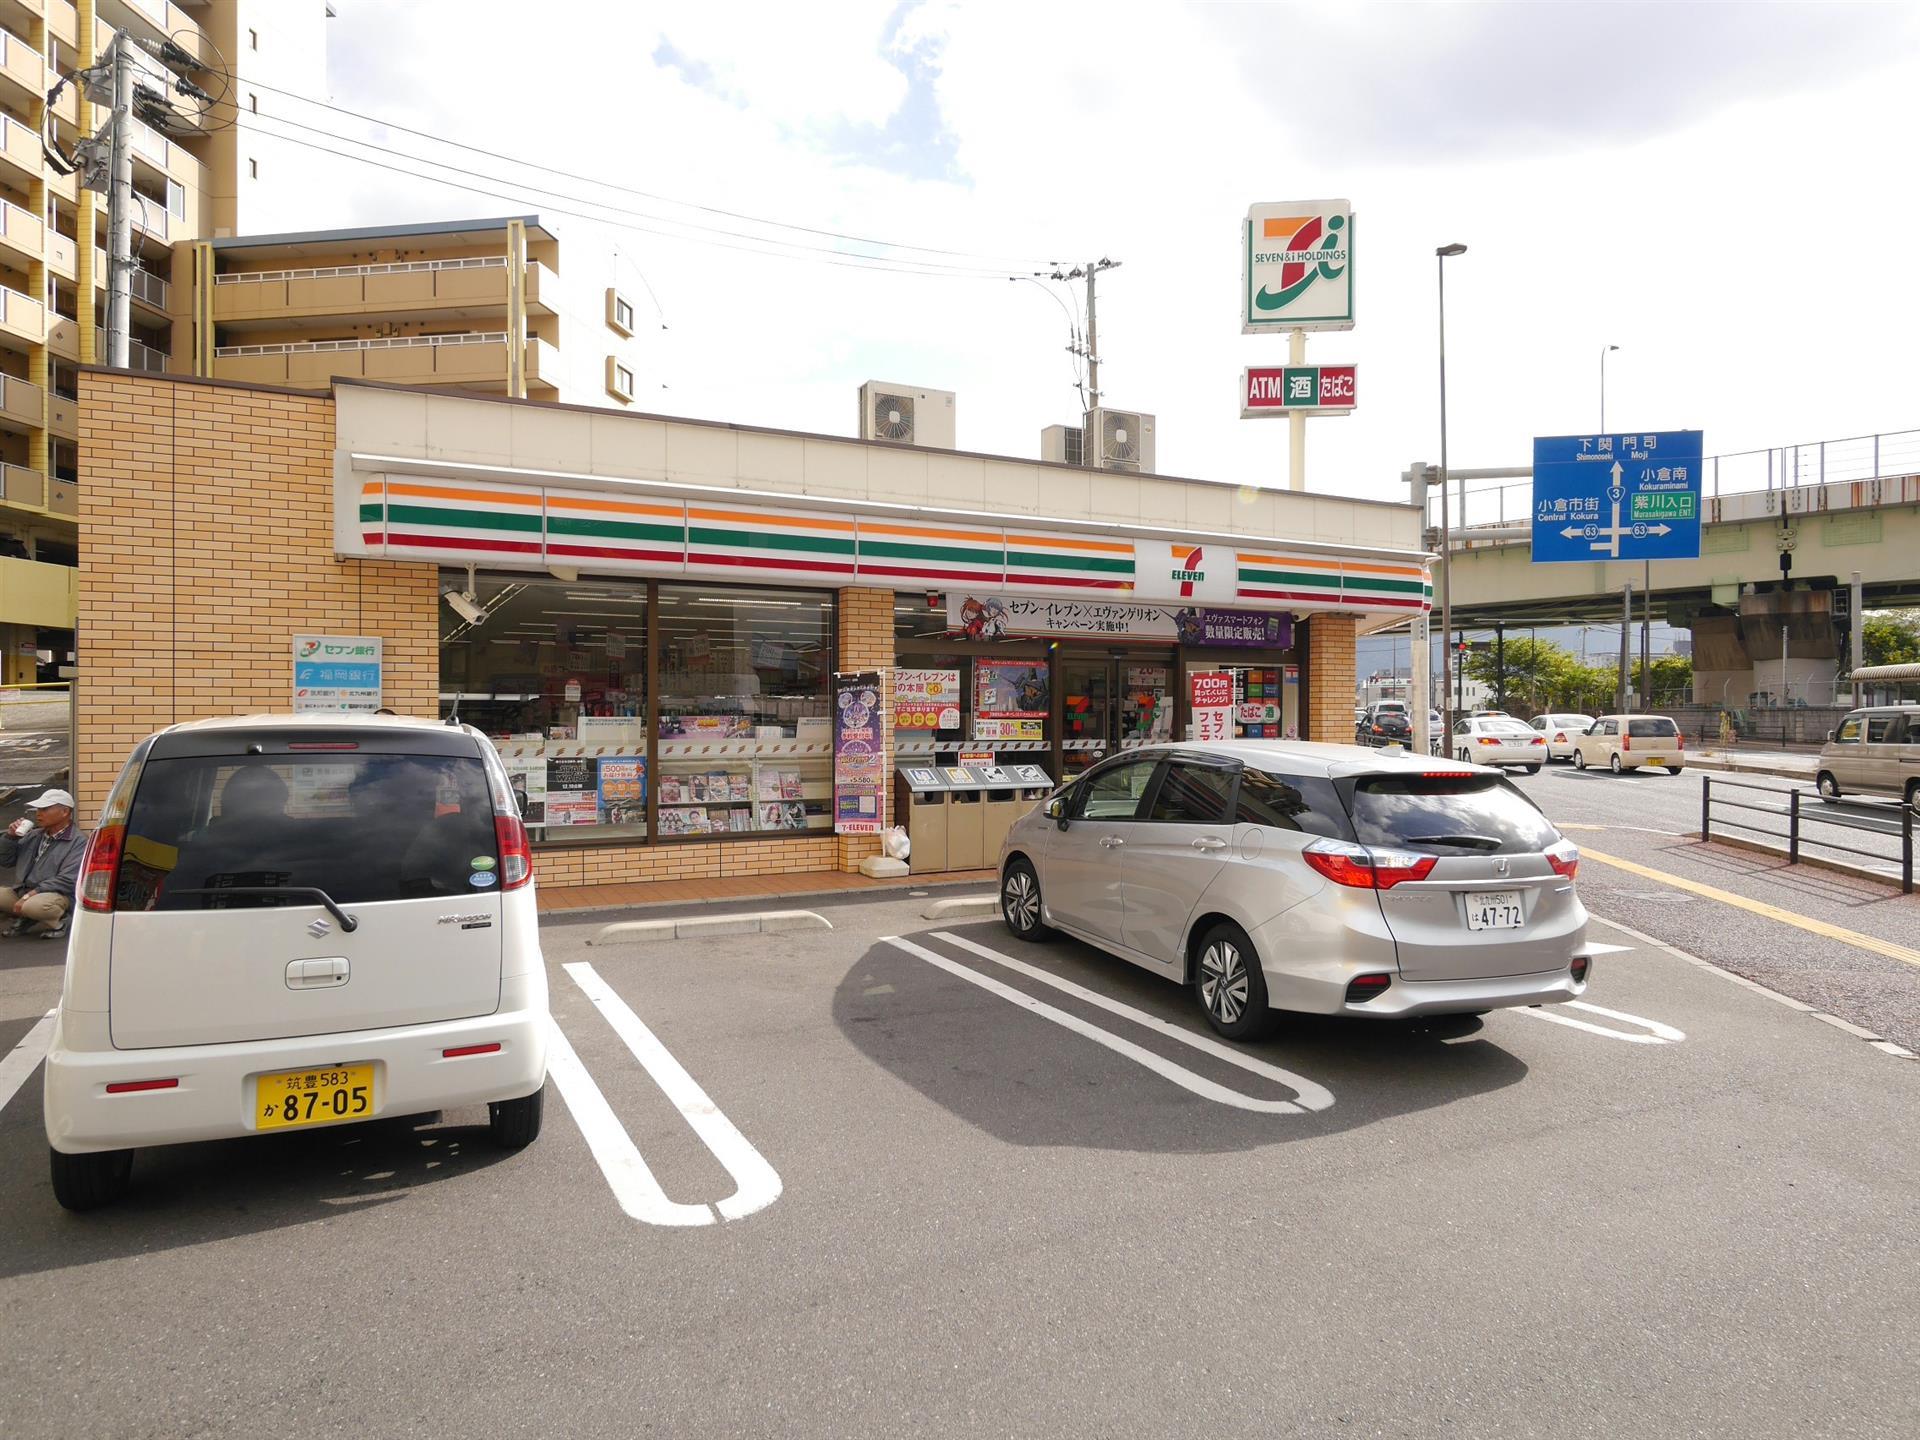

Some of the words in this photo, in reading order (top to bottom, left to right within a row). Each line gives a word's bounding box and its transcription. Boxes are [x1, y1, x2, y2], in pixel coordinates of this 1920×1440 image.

[1297, 250, 1346, 262] HOLDINGS
[1249, 377, 1281, 399] ATM
[1290, 376, 1312, 399] 酒
[1320, 375, 1354, 398] たばこ
[1578, 437, 1613, 452] 下関
[1622, 435, 1657, 450] 門司
[1576, 452, 1614, 461] Shimonoseki
[1631, 451, 1649, 461] Moji
[1640, 467, 1688, 482] 小倉南
[1639, 482, 1689, 491] Kokuraminami
[1612, 488, 1620, 499] 3
[1538, 497, 1600, 512] 小倉市街
[1634, 495, 1692, 509] 紫川入口
[1538, 513, 1566, 522] Central
[1570, 511, 1599, 521] Kokura
[1633, 510, 1677, 520] Murasakigawa
[1585, 526, 1596, 537] 63
[1634, 525, 1645, 536] 63
[1204, 613, 1265, 626] エヴァスマートフォン
[1204, 626, 1266, 642] 数量限定販売!
[324, 644, 376, 656] セブン銀行
[320, 669, 376, 681] 福岡銀行
[893, 671, 957, 682] ブン-イレブンは
[1193, 678, 1229, 689] 700円
[1240, 704, 1261, 718] たばこ
[1265, 706, 1275, 719] 酒
[263, 1104, 279, 1117] か
[283, 1086, 368, 1121] 87-05
